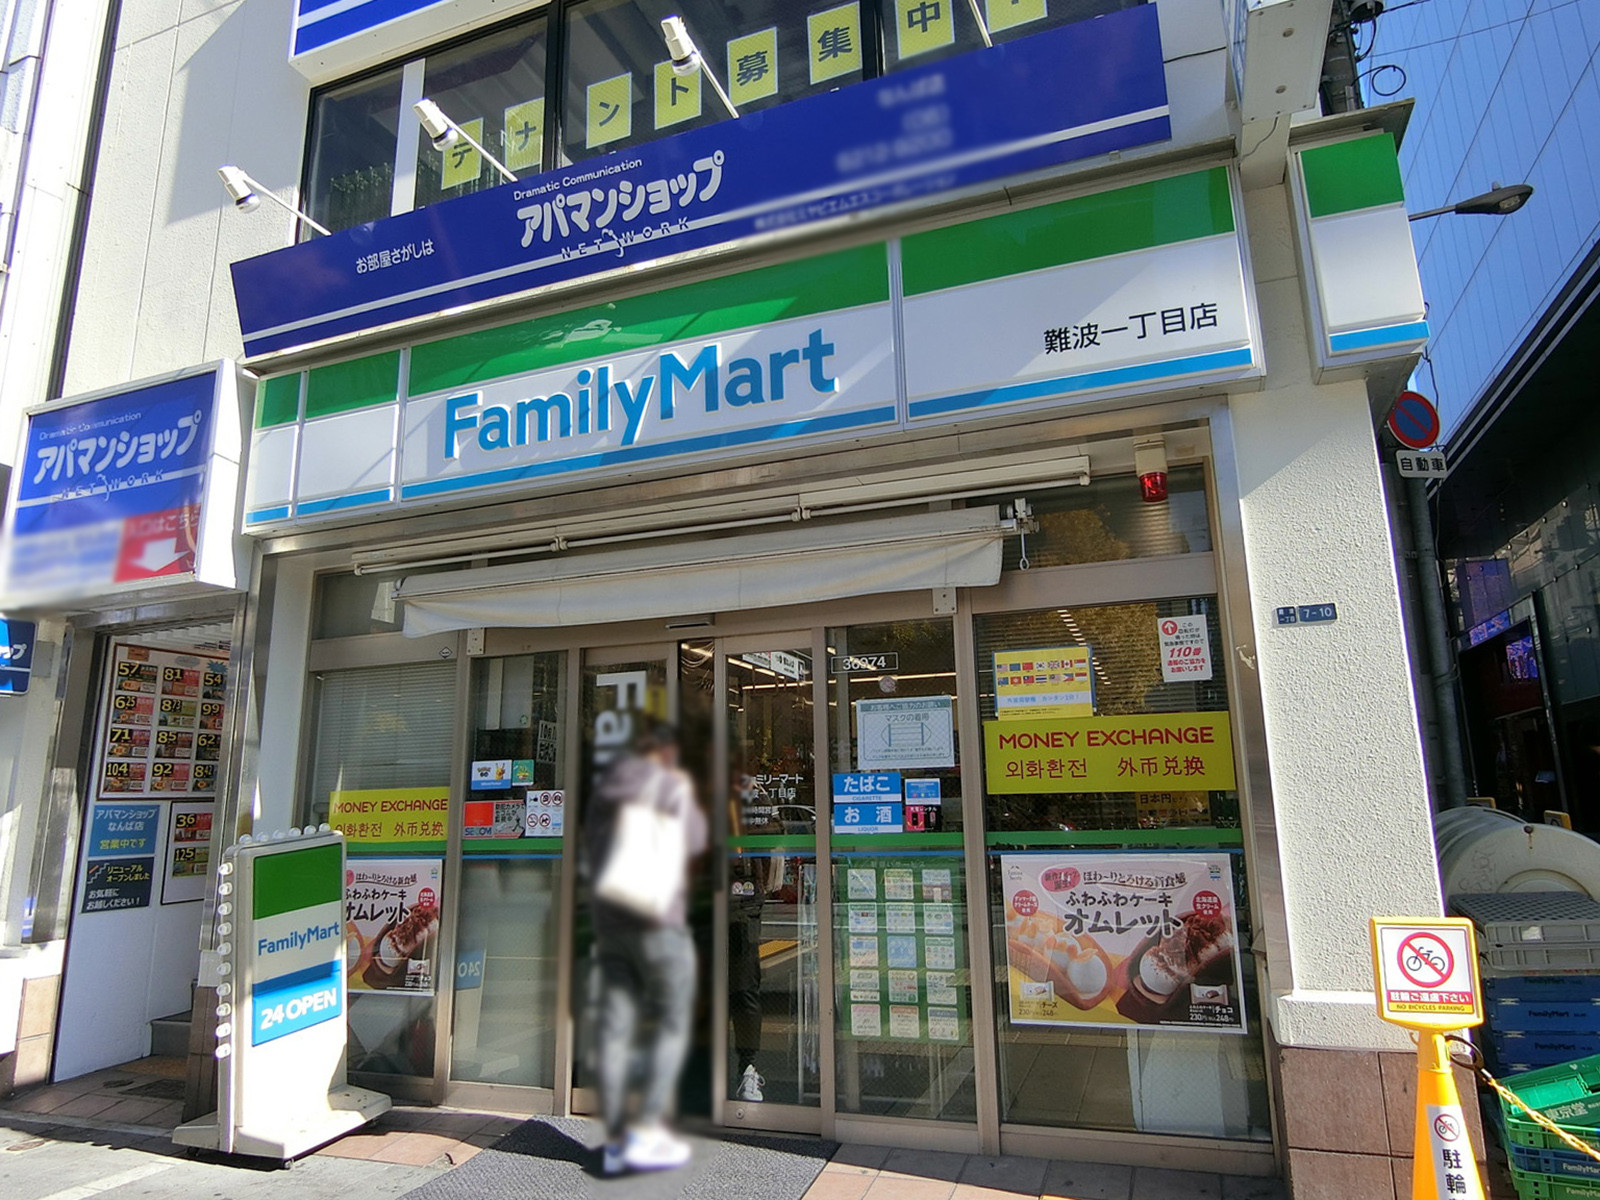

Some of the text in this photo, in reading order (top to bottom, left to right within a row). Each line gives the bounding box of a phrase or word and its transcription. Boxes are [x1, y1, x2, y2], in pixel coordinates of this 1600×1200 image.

[513, 158, 642, 200] Dramatic Communication
[516, 150, 725, 247] アパマンショップ
[355, 239, 435, 274] お部屋さがしは
[1044, 302, 1218, 355] 難波一丁目店
[443, 328, 840, 461] FamilyMart
[33, 409, 203, 485] アパマンショップ
[1400, 456, 1446, 471] 自動車
[1303, 607, 1332, 619] 7-10
[998, 726, 1215, 750] MONEY EXCHANGE
[1005, 757, 1089, 780] 외화환전
[1117, 755, 1206, 778] 外币兑换
[843, 775, 890, 793] たばこ
[96, 808, 157, 820] アパマンショップ
[334, 798, 449, 813] MONEY EXCHANGE
[393, 820, 444, 837] 外币兑换
[107, 864, 143, 875] リニューアル
[1066, 891, 1173, 907] ふわふわケーキ
[1064, 908, 1182, 936] オムレット
[258, 922, 340, 956] FamilyMart
[260, 987, 337, 1030] 24 OPEN
[1442, 1149, 1467, 1200] 駐輪
